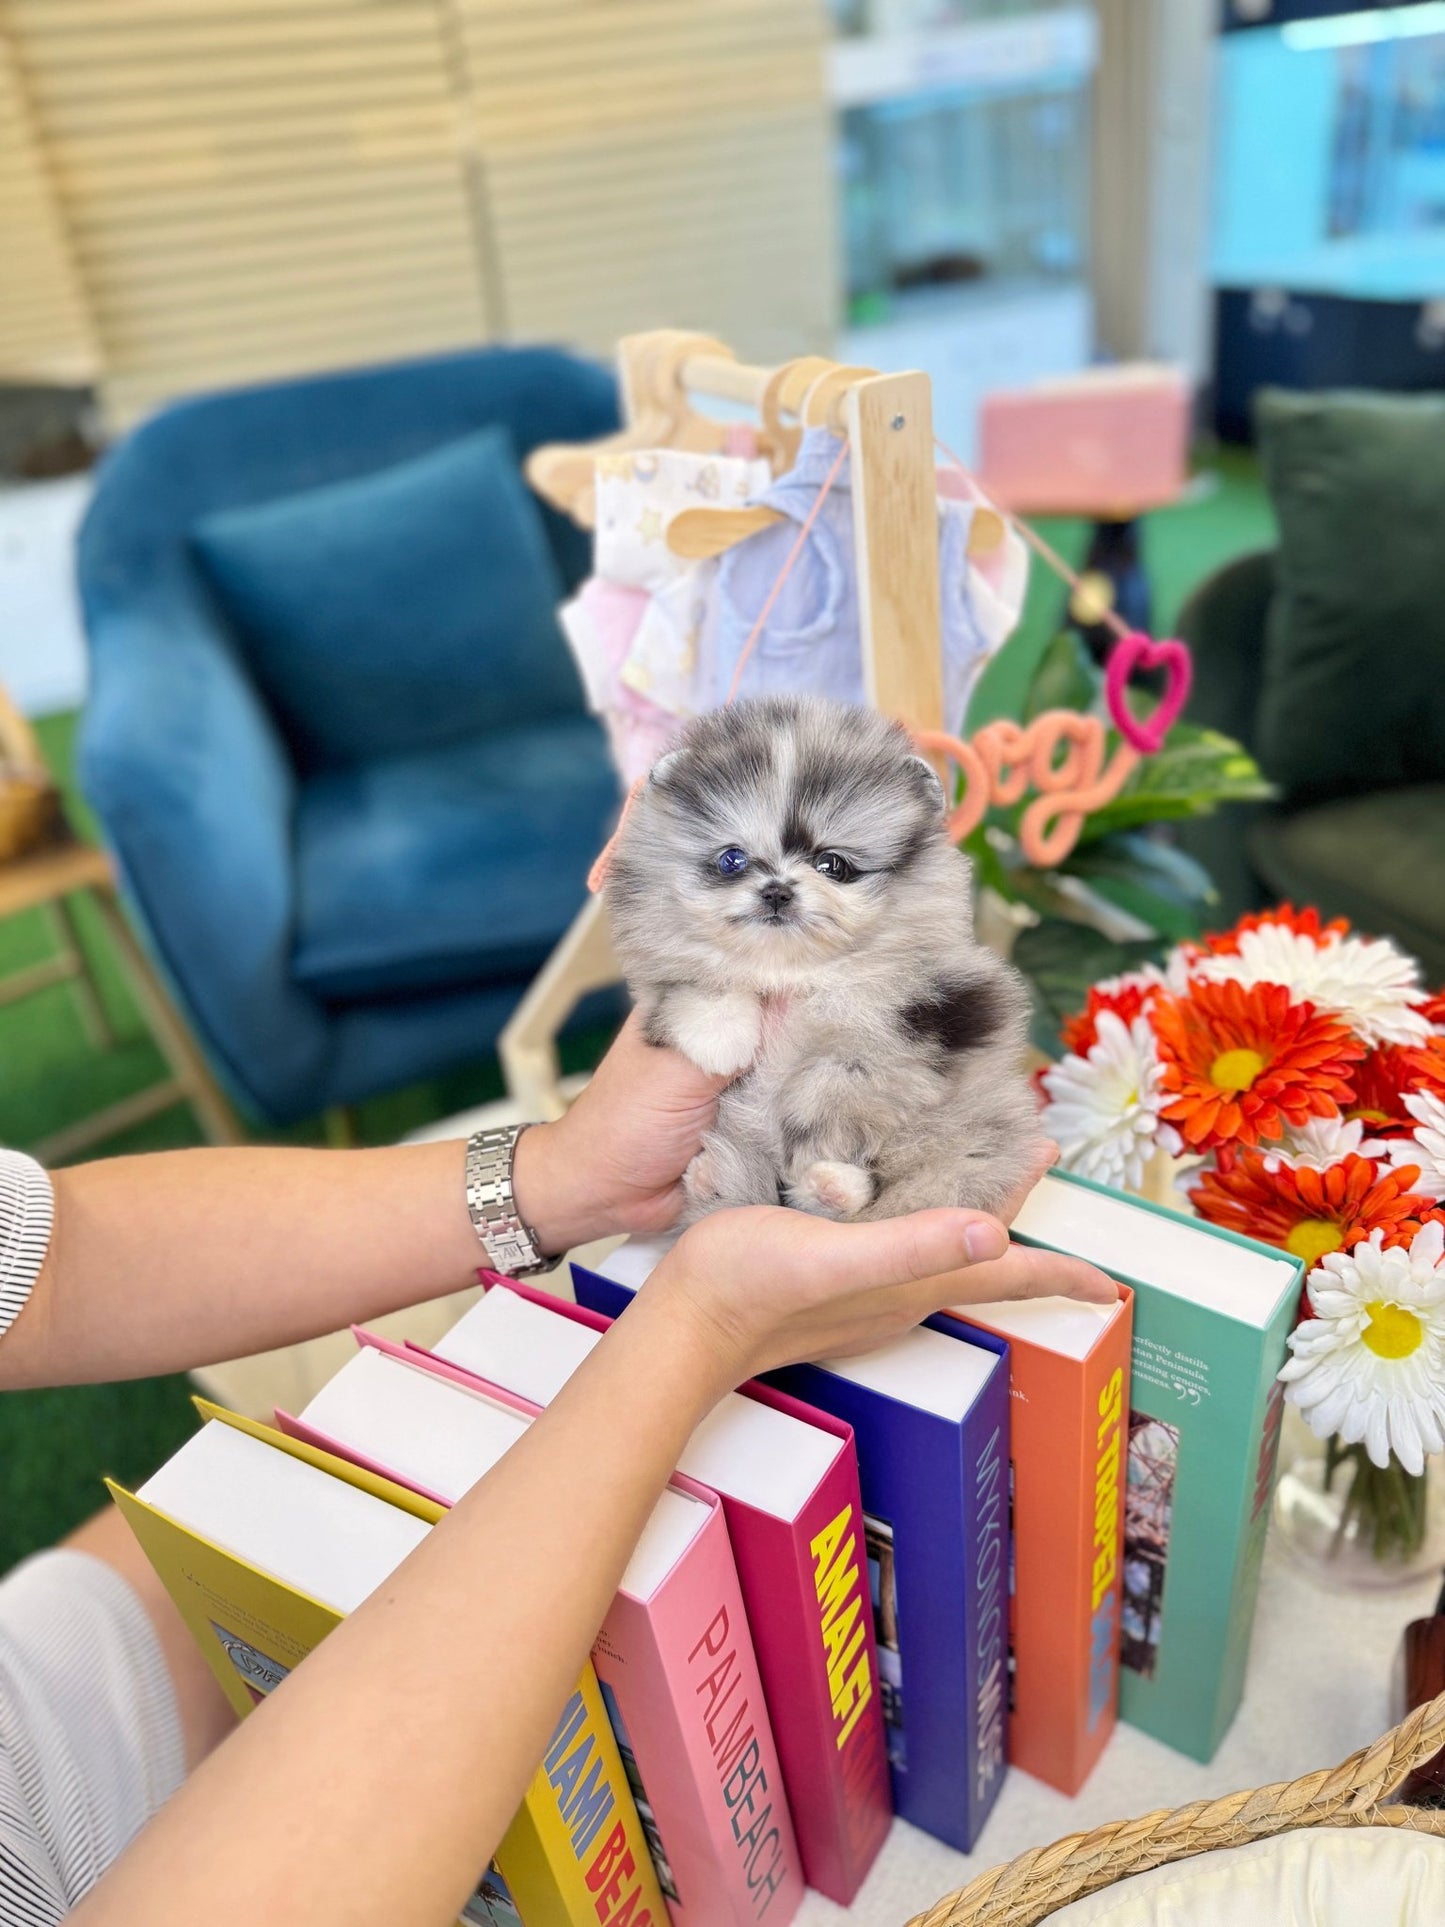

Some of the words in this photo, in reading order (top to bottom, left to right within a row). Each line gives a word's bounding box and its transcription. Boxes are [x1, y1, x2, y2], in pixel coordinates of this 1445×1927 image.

[1132, 1335, 1172, 1356] erfectly
[1174, 1351, 1209, 1372] distills
[1133, 1358, 1169, 1379] erizing
[809, 1502, 873, 1752] AMALFI
[976, 1424, 1001, 1688] MYKONOS
[1091, 1425, 1121, 1613] TROPEZ
[543, 1689, 616, 1862] IAMI
[584, 1818, 657, 1927] BEA
[687, 1603, 755, 1784] PALM
[723, 1737, 787, 1921] BEACH
